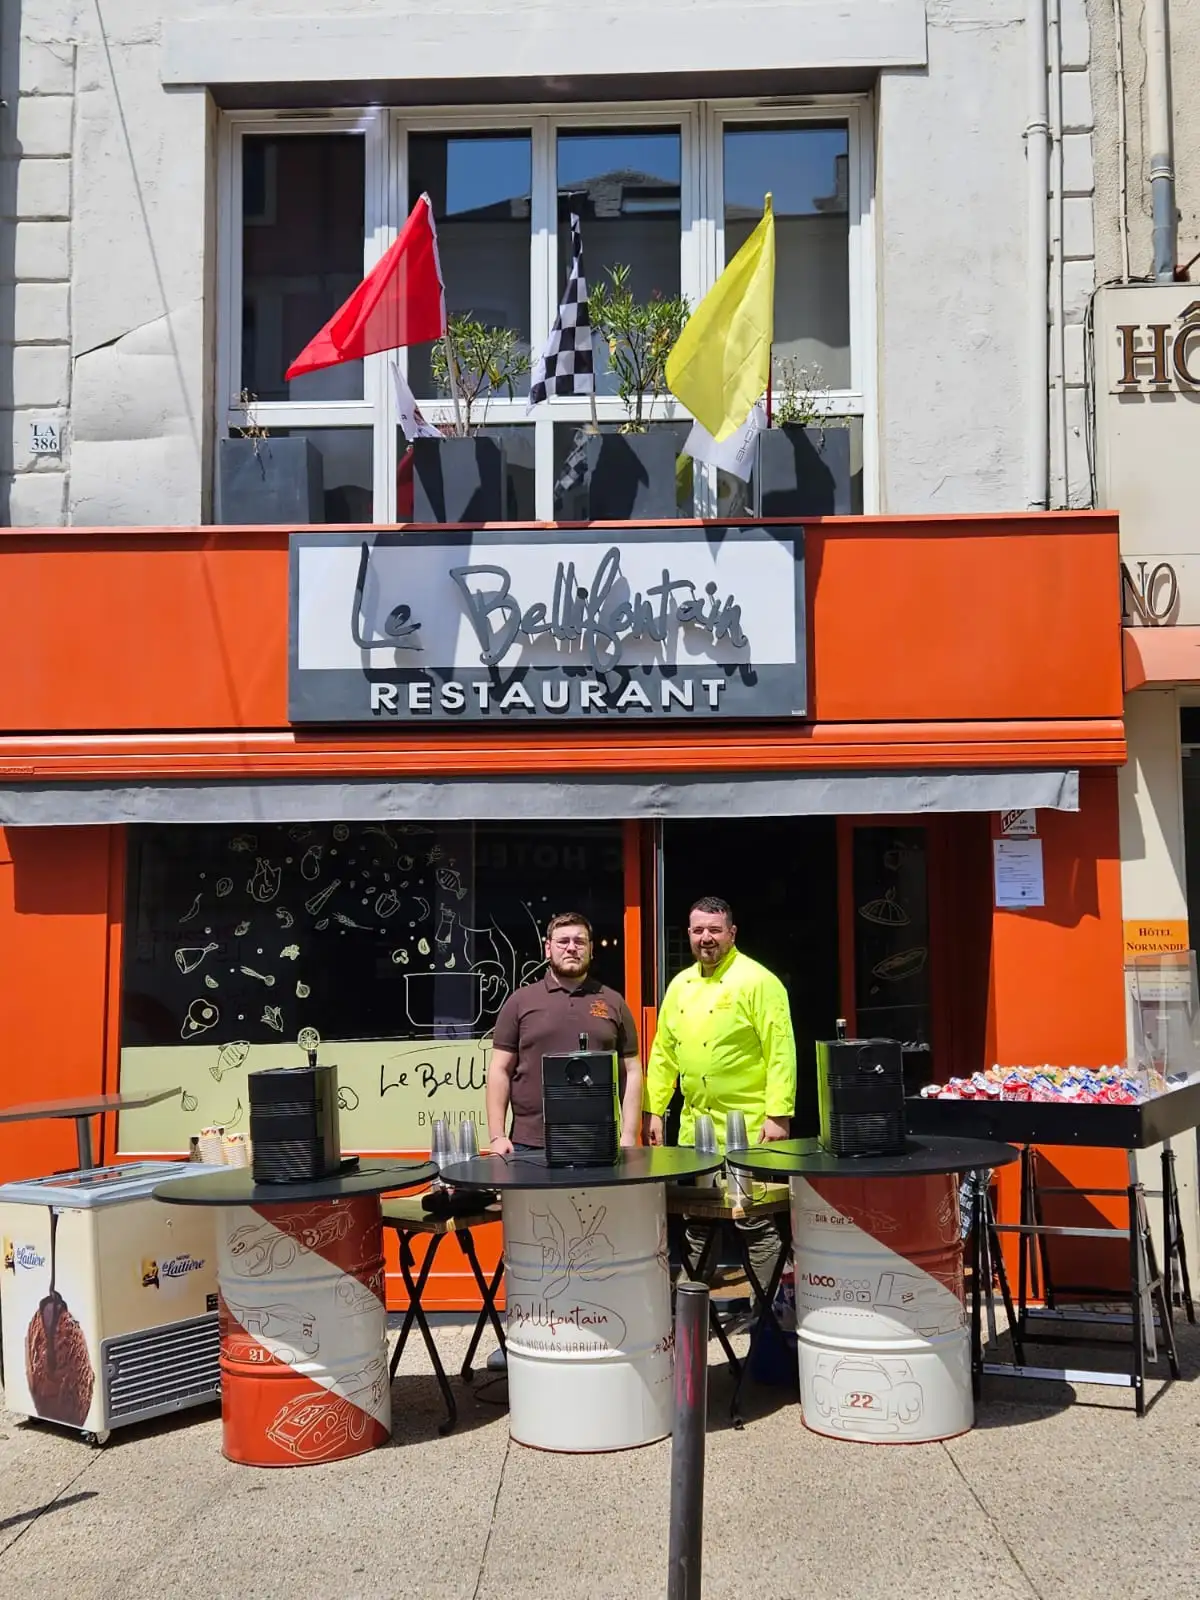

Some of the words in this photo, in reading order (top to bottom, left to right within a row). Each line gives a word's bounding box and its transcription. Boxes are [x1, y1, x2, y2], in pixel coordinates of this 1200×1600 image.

[33, 425, 56, 436] LA
[31, 438, 58, 450] 386
[351, 541, 424, 650] Le
[449, 546, 748, 673] Bellifontain
[370, 678, 727, 712] RESTAURANT
[1126, 942, 1186, 952] NORMANDIE
[380, 1064, 409, 1098] Le
[418, 1111, 435, 1126] BY
[815, 1213, 827, 1222] Silk
[830, 1215, 844, 1225] Cut
[303, 1228, 319, 1247] 3
[303, 1323, 312, 1338] 21
[249, 1349, 265, 1362] 21
[850, 1393, 874, 1408] 22
[294, 1406, 321, 1425] 23
